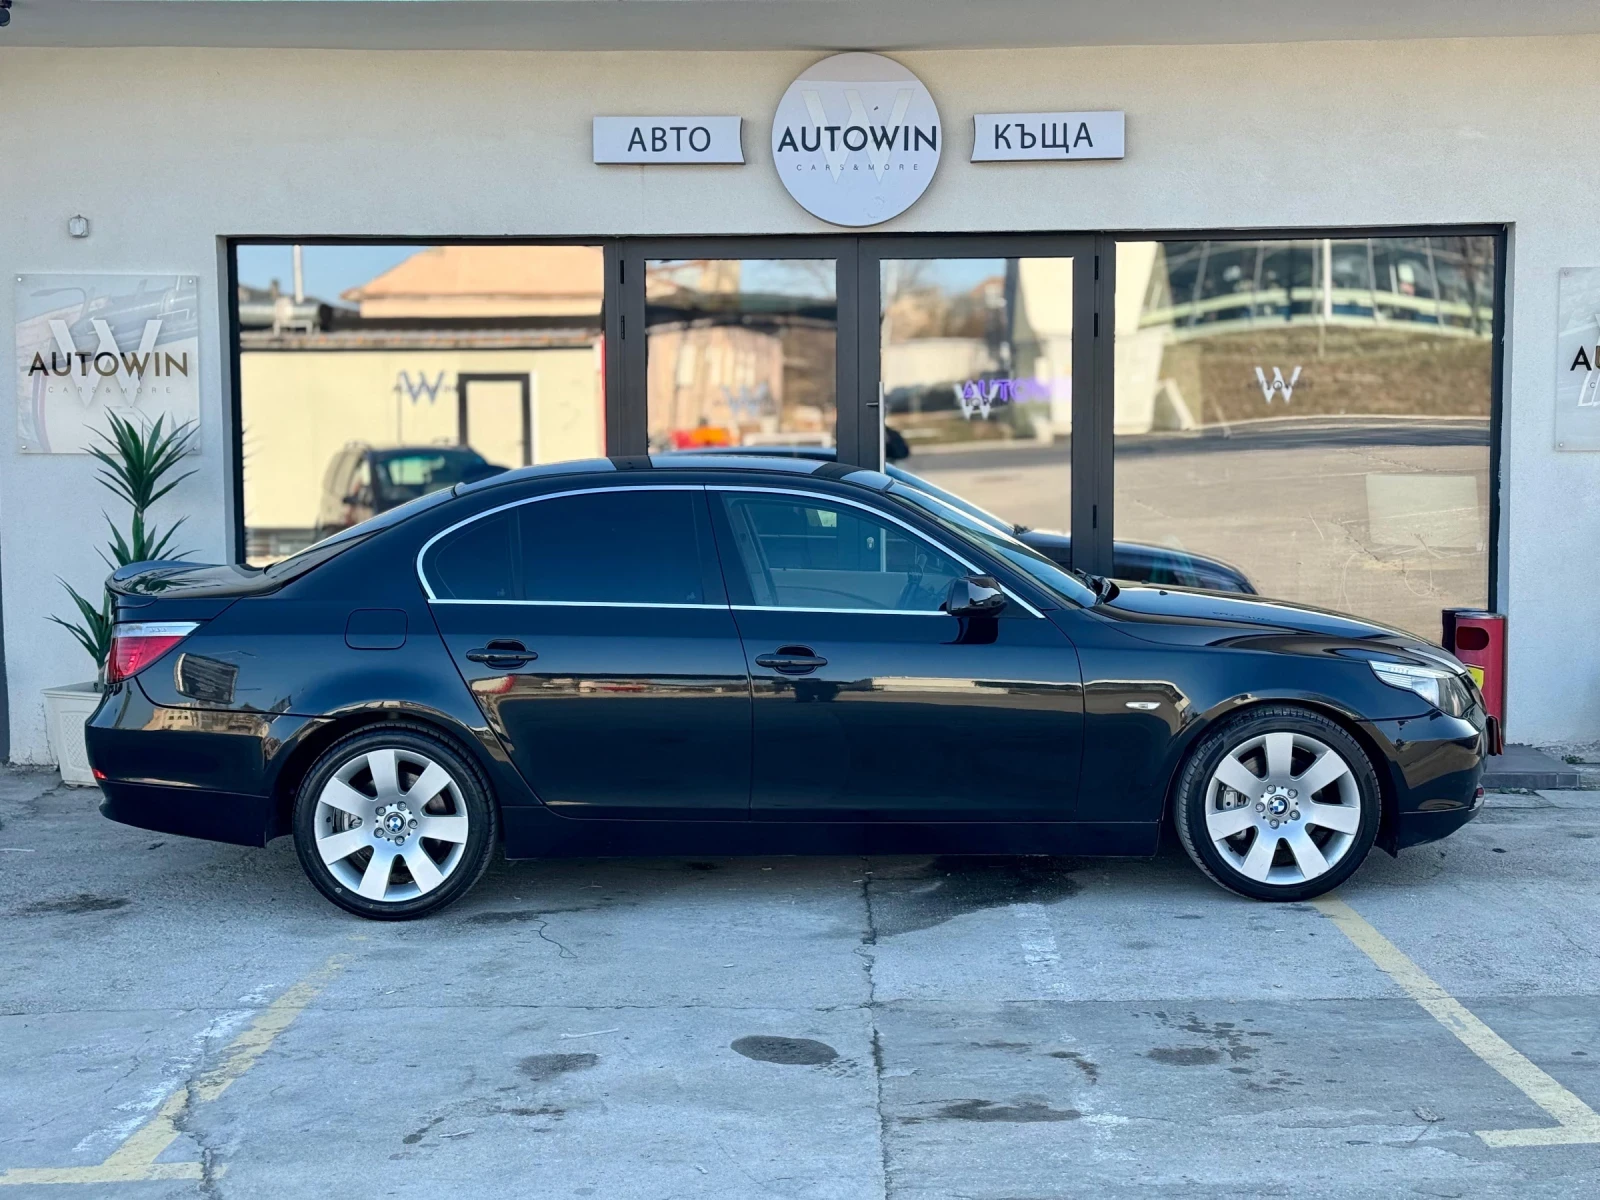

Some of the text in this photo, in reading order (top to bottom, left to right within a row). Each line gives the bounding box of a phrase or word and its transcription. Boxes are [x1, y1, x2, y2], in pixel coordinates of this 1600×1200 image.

[627, 126, 711, 152] АВТО
[777, 125, 937, 152] AUTOWIN
[994, 122, 1094, 154] КЪЩА
[28, 351, 189, 377] AUTOWIN
